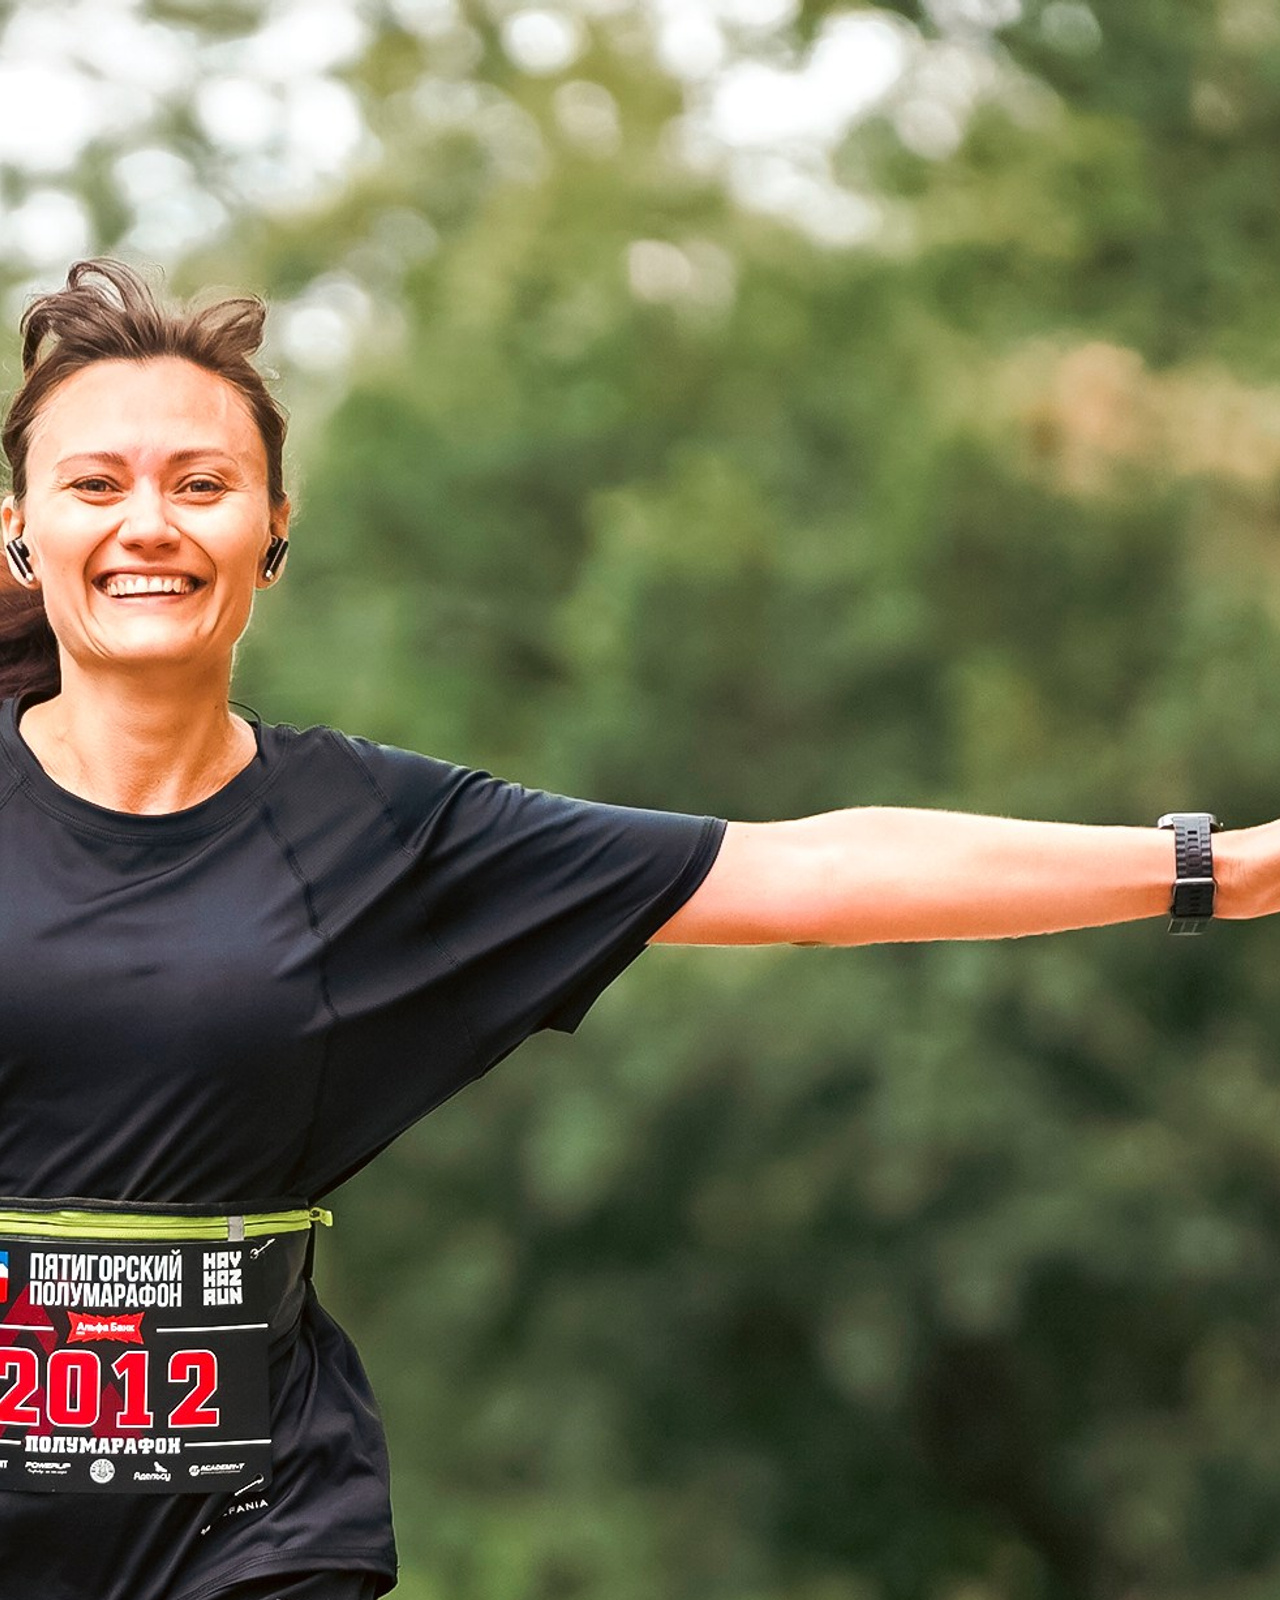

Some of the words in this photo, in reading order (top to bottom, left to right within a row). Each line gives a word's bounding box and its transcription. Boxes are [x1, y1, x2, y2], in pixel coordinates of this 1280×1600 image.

[29, 1248, 183, 1282] ПЯТИГОРСКИЙ
[29, 1281, 183, 1308] ПОЛУМАРАФОН
[76, 1321, 109, 1334] Альфа
[110, 1321, 136, 1333] Банк
[24, 1436, 181, 1455] ПОЛУМАРАФОН
[24, 1461, 72, 1470] POWERUP
